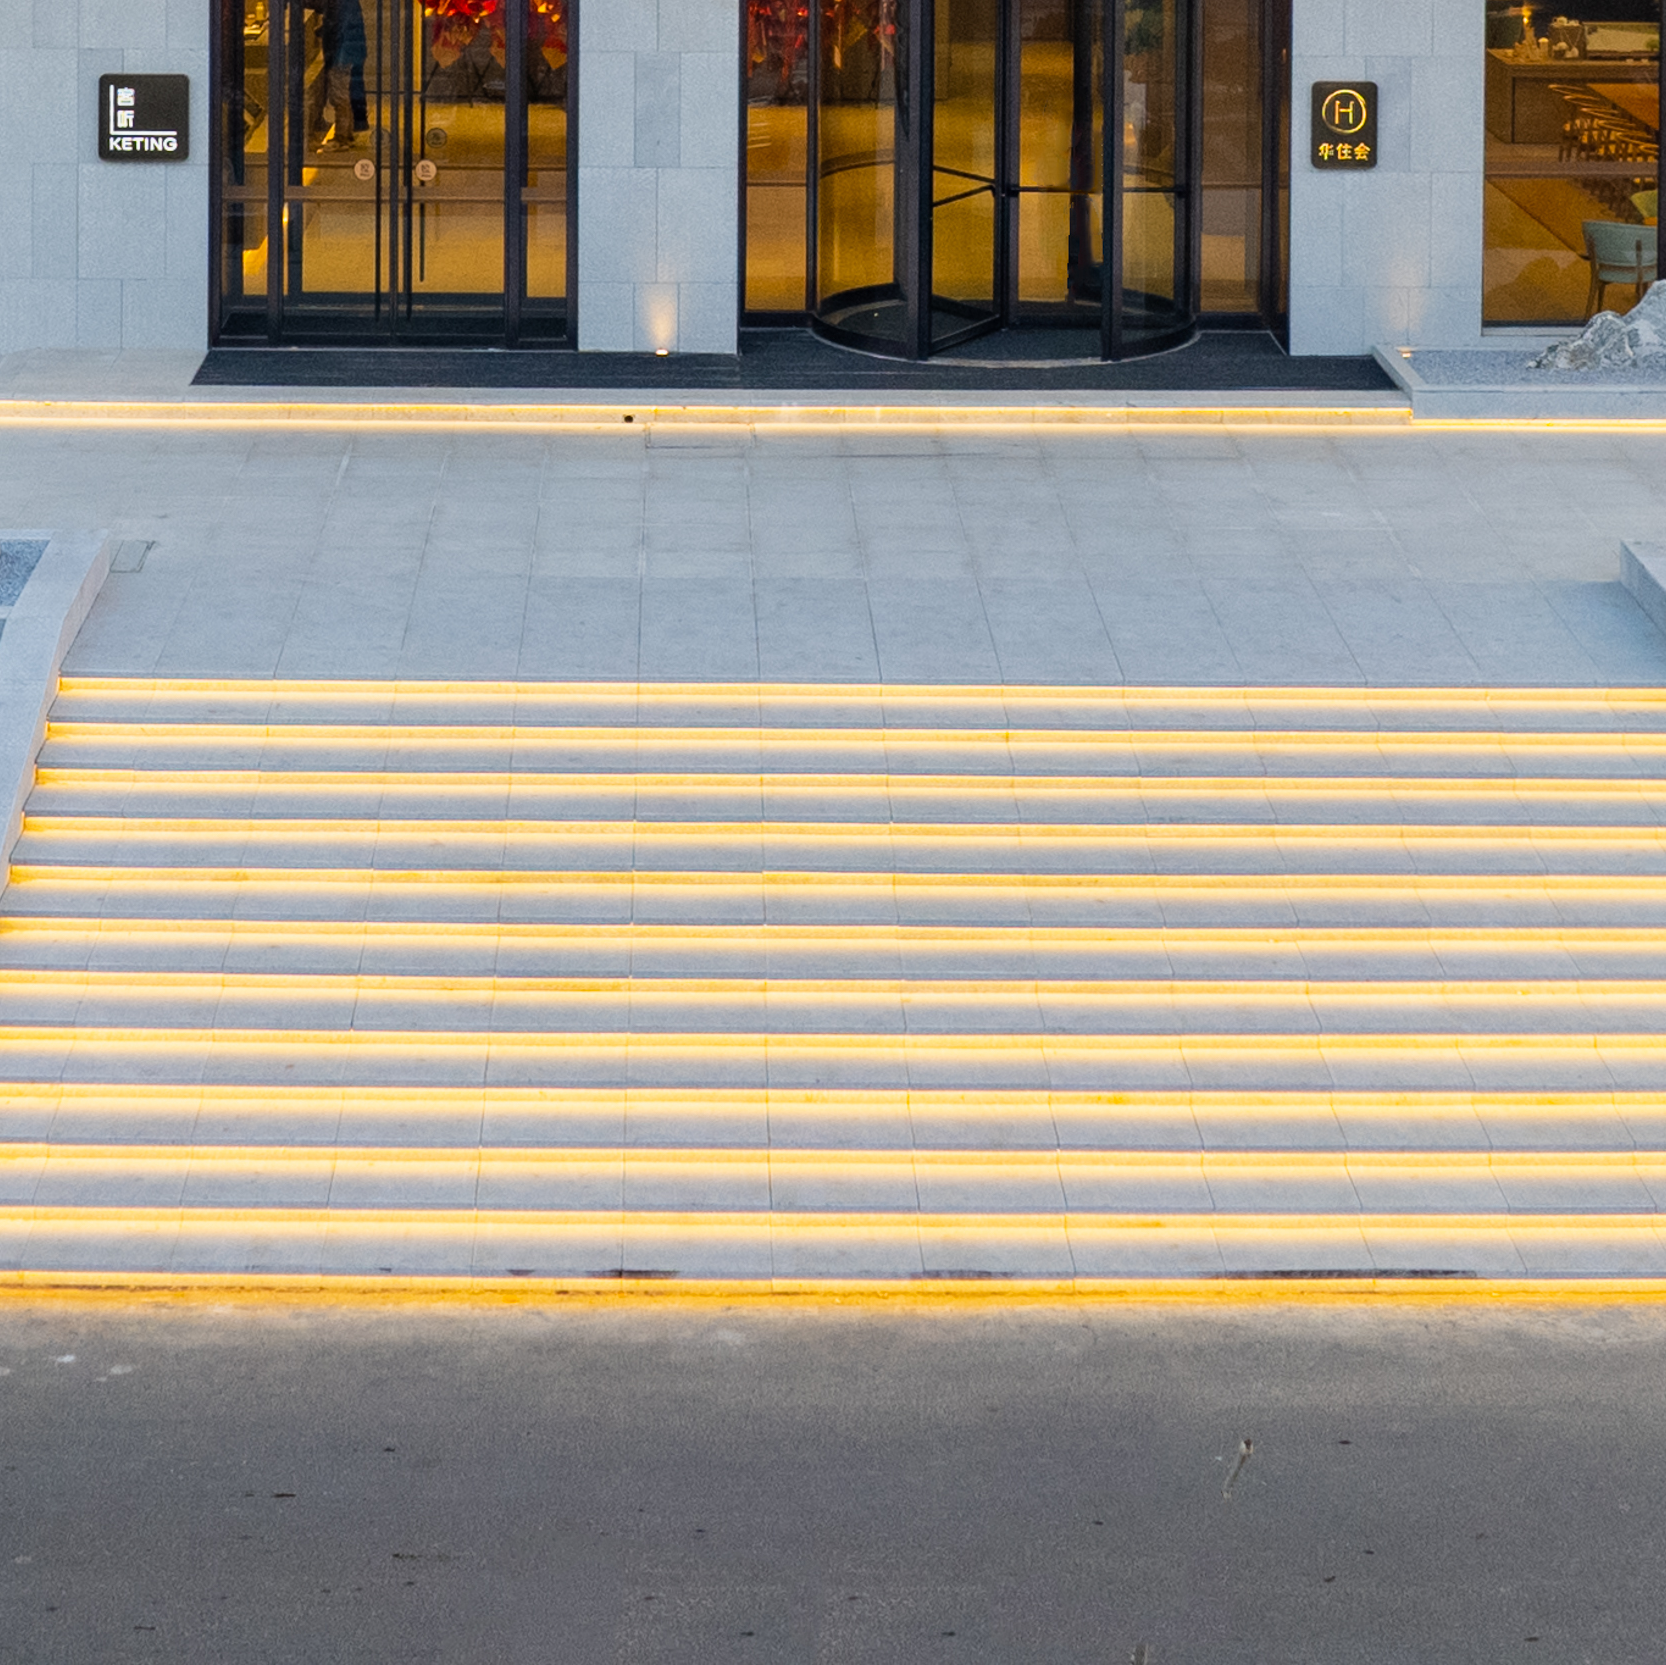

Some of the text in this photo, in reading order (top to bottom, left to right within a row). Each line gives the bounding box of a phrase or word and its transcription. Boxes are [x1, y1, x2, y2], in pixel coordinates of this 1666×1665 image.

[109, 136, 178, 152] KETING
[1318, 142, 1371, 161] 华住会
